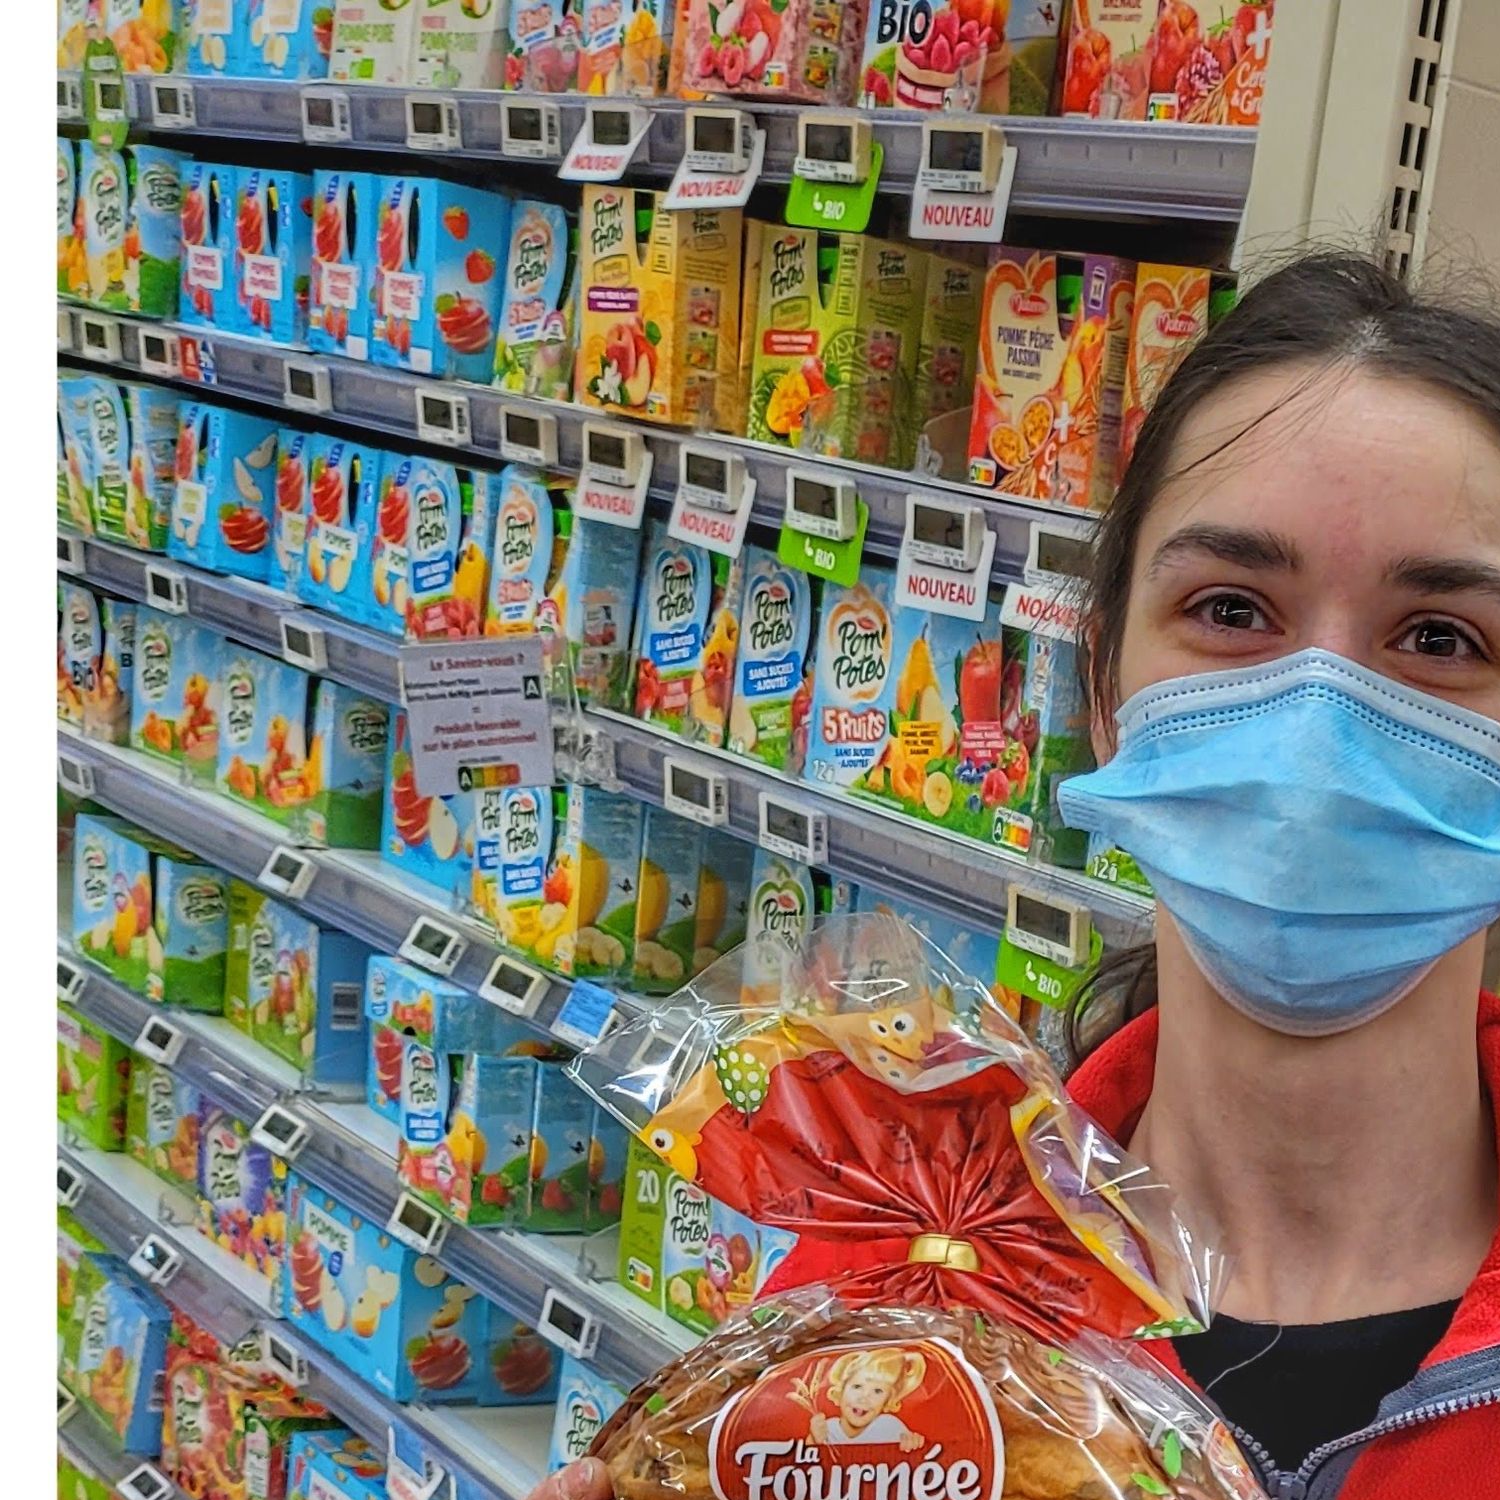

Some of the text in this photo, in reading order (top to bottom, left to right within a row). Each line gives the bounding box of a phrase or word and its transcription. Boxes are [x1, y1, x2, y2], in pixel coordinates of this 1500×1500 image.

[877, 0, 933, 45] BIO
[676, 177, 744, 198] NOUVEAU
[822, 200, 846, 221] BIO
[922, 205, 994, 228] NOUVEAU
[584, 490, 635, 516] NOUVEAU
[679, 510, 736, 543] NOUVEAU
[814, 548, 835, 571] BIO
[907, 574, 977, 606] NOUVEAU
[750, 619, 793, 650] Potes
[833, 655, 886, 690] Potes
[823, 708, 838, 741] 5
[838, 708, 887, 740] Fruits
[1092, 856, 1109, 879] 12
[1037, 974, 1063, 998] BIO
[636, 1169, 660, 1204] 20
[670, 1216, 709, 1244] Potes
[795, 1440, 820, 1465] la
